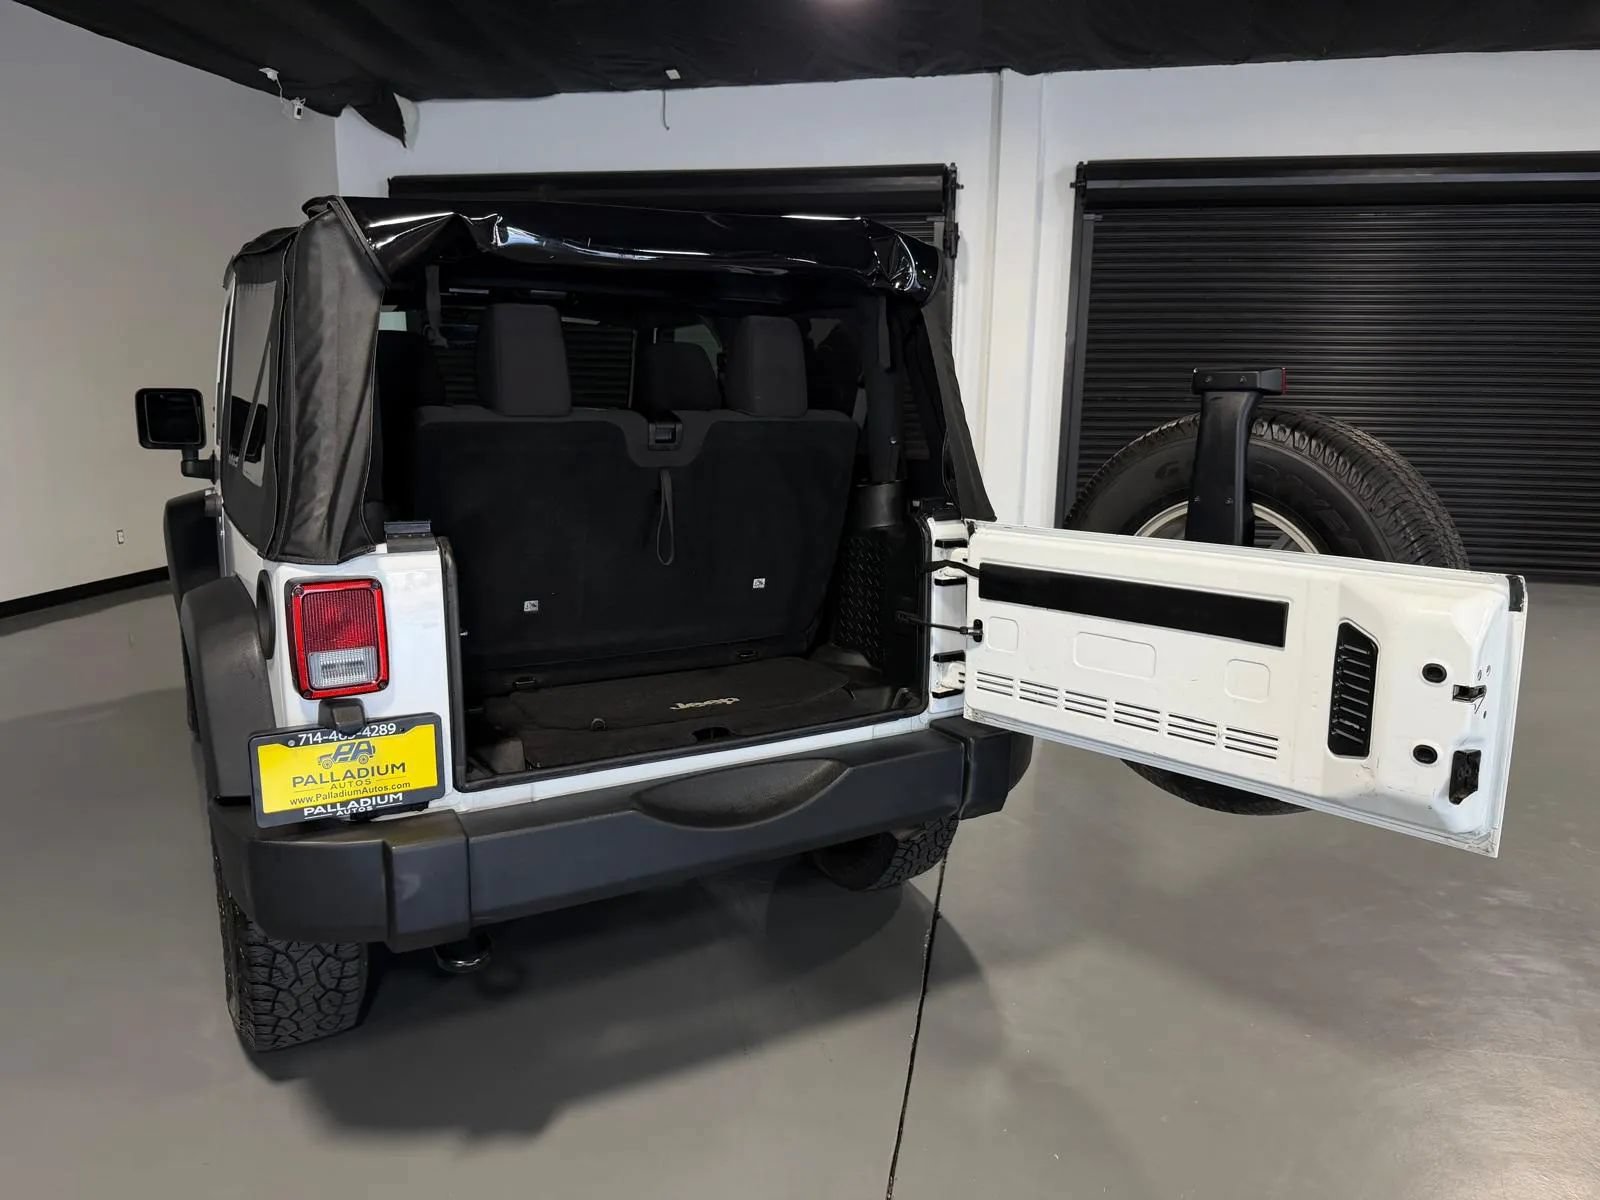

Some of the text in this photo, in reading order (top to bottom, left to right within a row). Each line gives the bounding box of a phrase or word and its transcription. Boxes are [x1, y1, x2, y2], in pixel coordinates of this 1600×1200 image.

[669, 697, 741, 710] Jeep
[298, 723, 397, 746] 714-4-4289
[292, 762, 406, 788] PALLADIUM
[330, 778, 372, 790] AUTOS
[290, 782, 411, 805] www.PalladiumAutos.com
[304, 793, 403, 816] PALLADIUM
[336, 805, 373, 816] AUTOS
